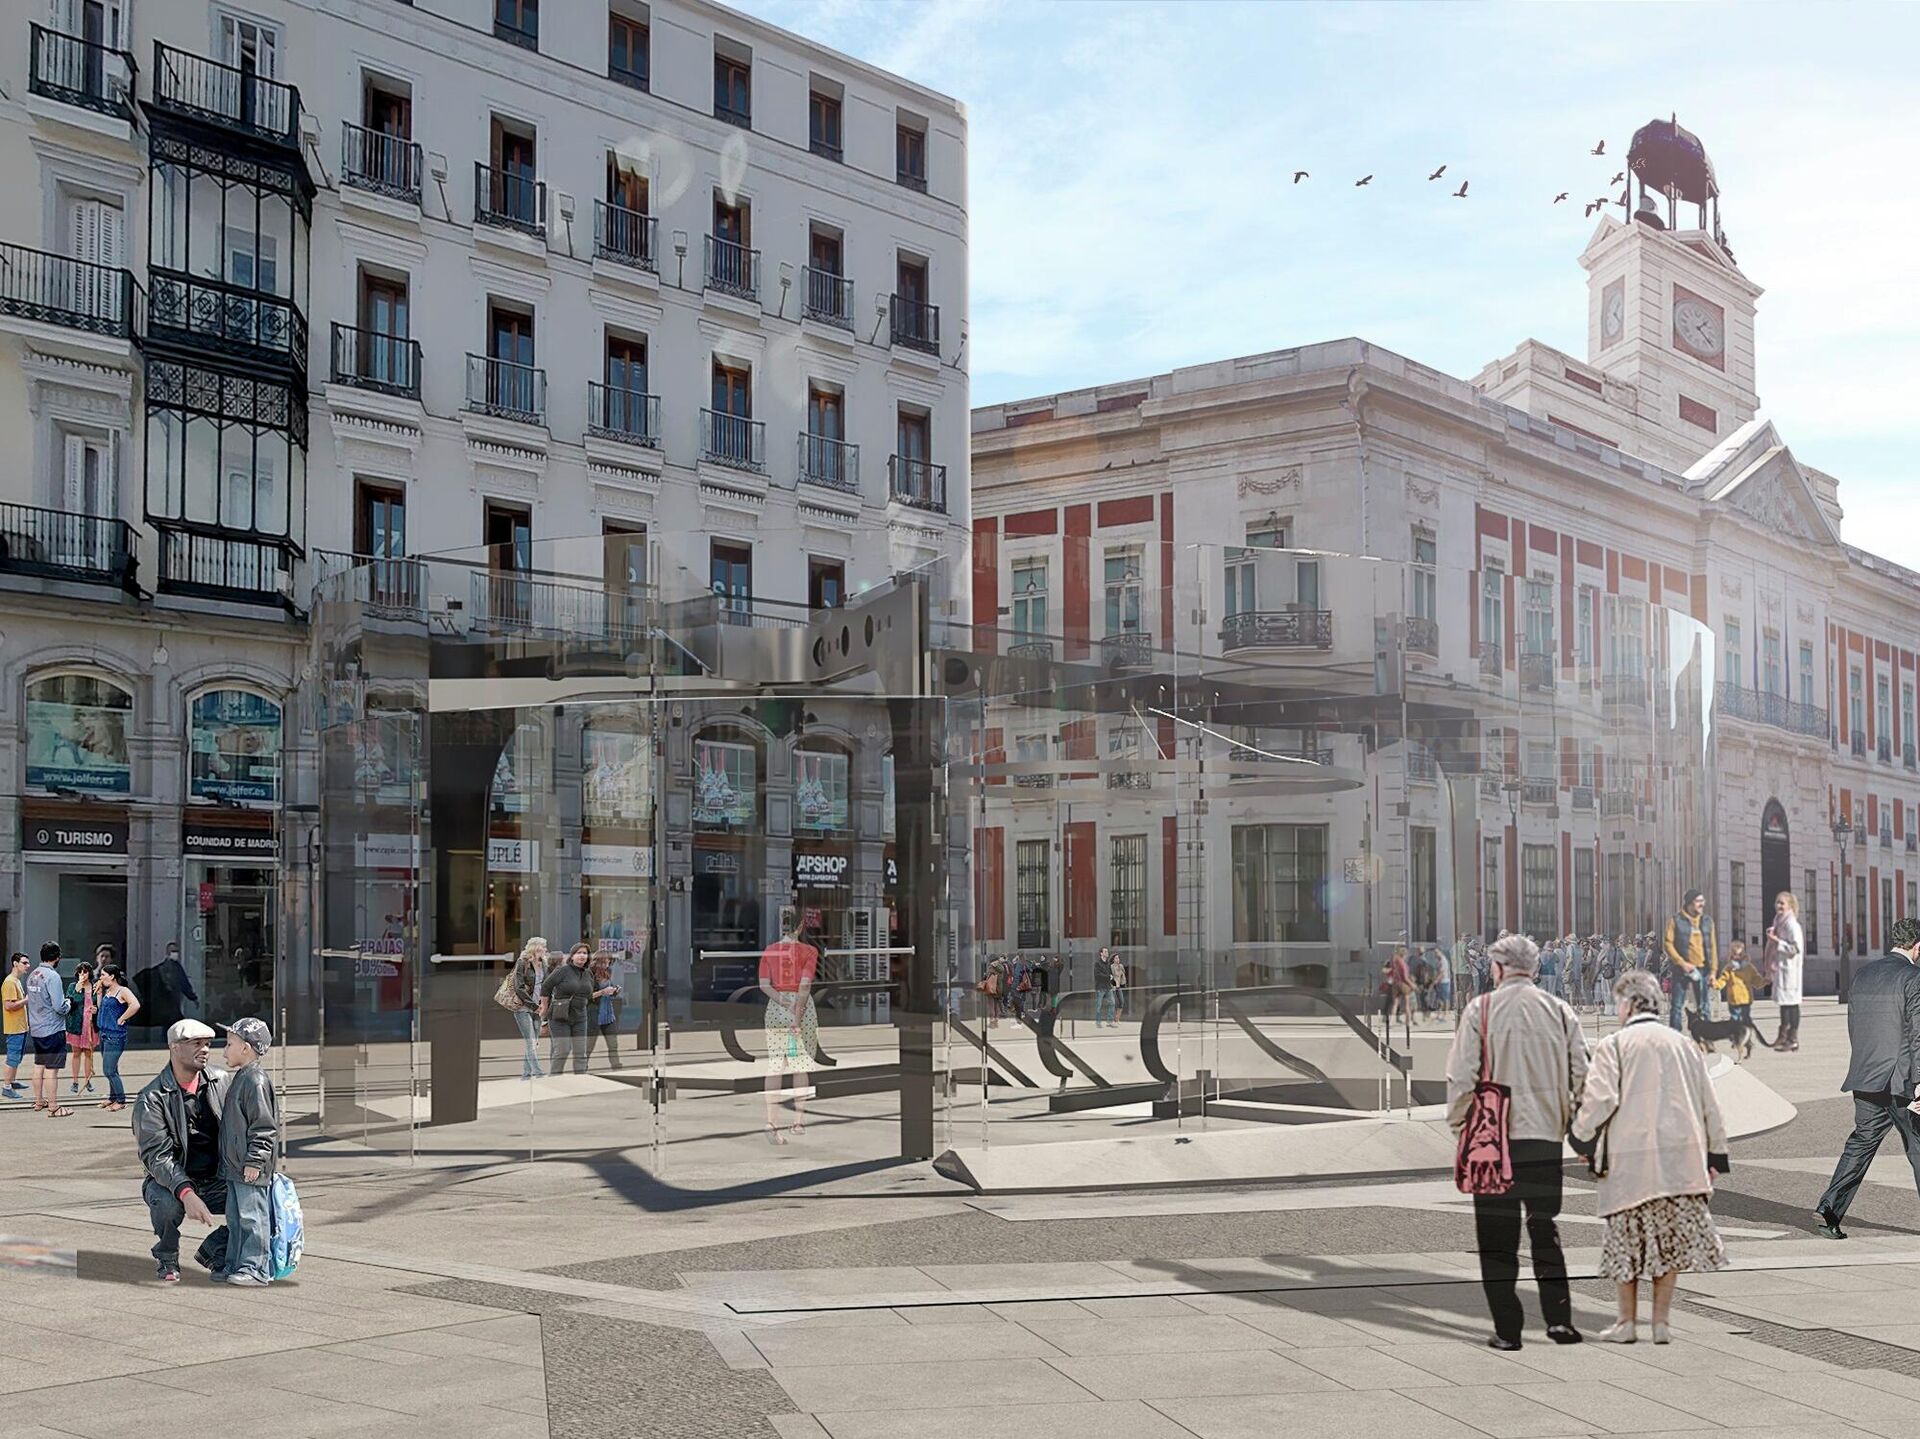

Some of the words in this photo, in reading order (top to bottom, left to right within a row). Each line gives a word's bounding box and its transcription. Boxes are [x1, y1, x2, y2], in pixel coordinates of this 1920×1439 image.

[55, 831, 113, 846] TURISMO
[234, 838, 247, 847] DE
[488, 842, 521, 863] UPLÉ
[796, 855, 847, 873] APSHOP
